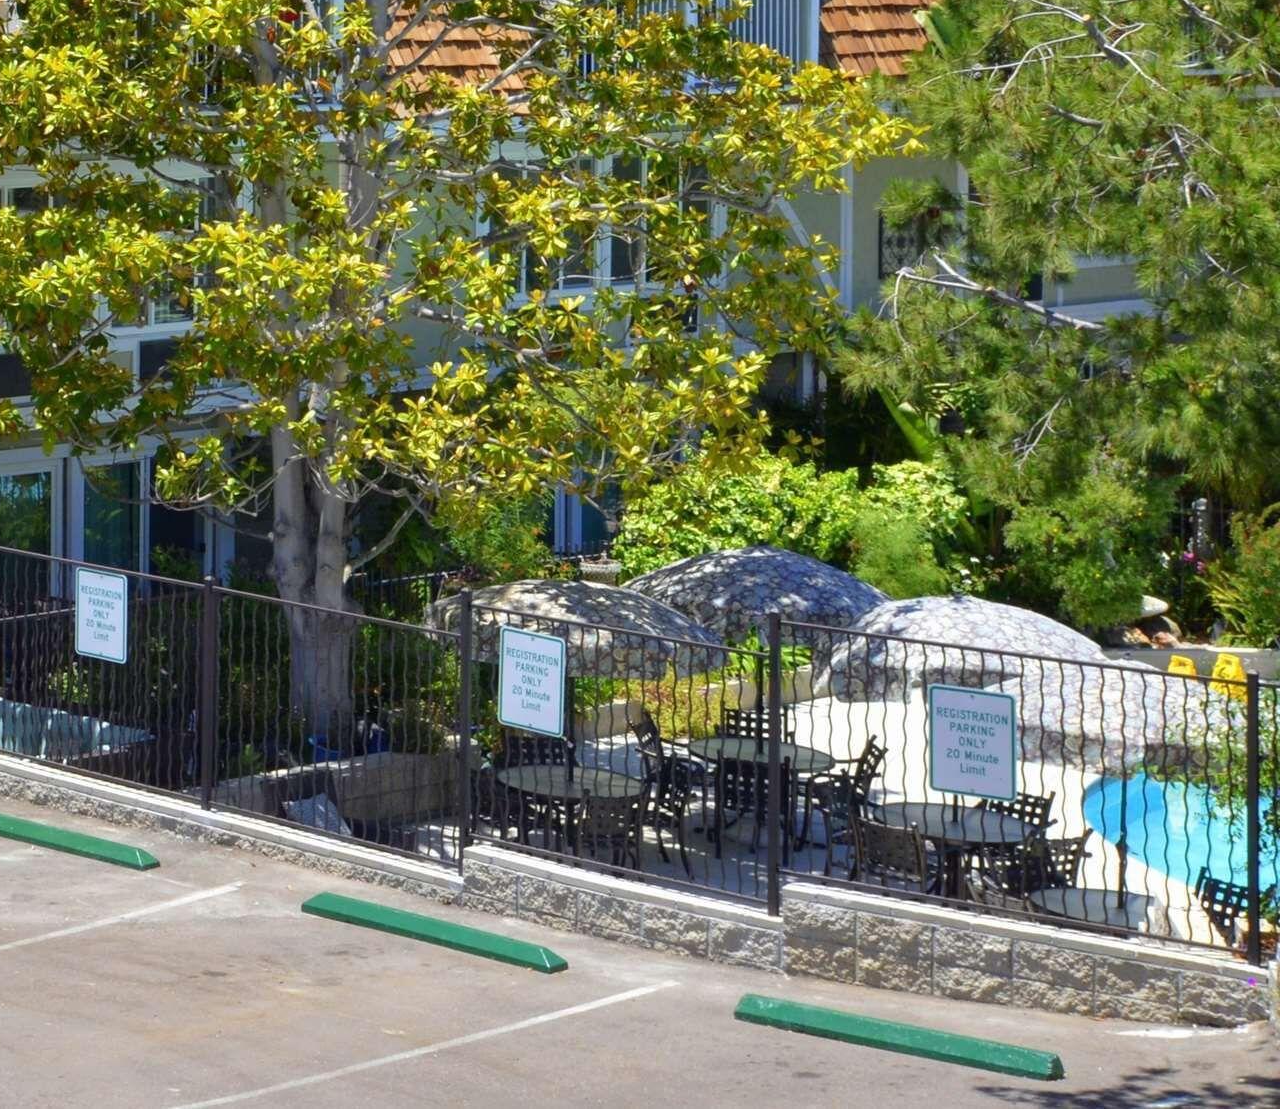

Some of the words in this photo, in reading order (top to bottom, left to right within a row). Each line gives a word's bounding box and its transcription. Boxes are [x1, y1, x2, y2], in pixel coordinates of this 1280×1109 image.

[80, 585, 122, 601] REGISTRATION
[88, 597, 115, 610] PARKING
[93, 609, 110, 619] ONLY
[86, 618, 95, 627] 20
[96, 620, 116, 632] Minute
[93, 631, 110, 642] Limit
[506, 647, 559, 667] REGISTRATION
[515, 661, 549, 677] PARKING
[521, 675, 542, 687] ONLY
[512, 684, 523, 695] 20
[525, 688, 550, 702] Minute
[521, 699, 541, 713] Limit
[936, 706, 1008, 725] REGISTRATION
[949, 721, 995, 737] PARKING
[958, 736, 986, 749] ONLY
[946, 748, 960, 759] 20
[964, 750, 999, 765] Minute
[960, 762, 987, 777] Limit
